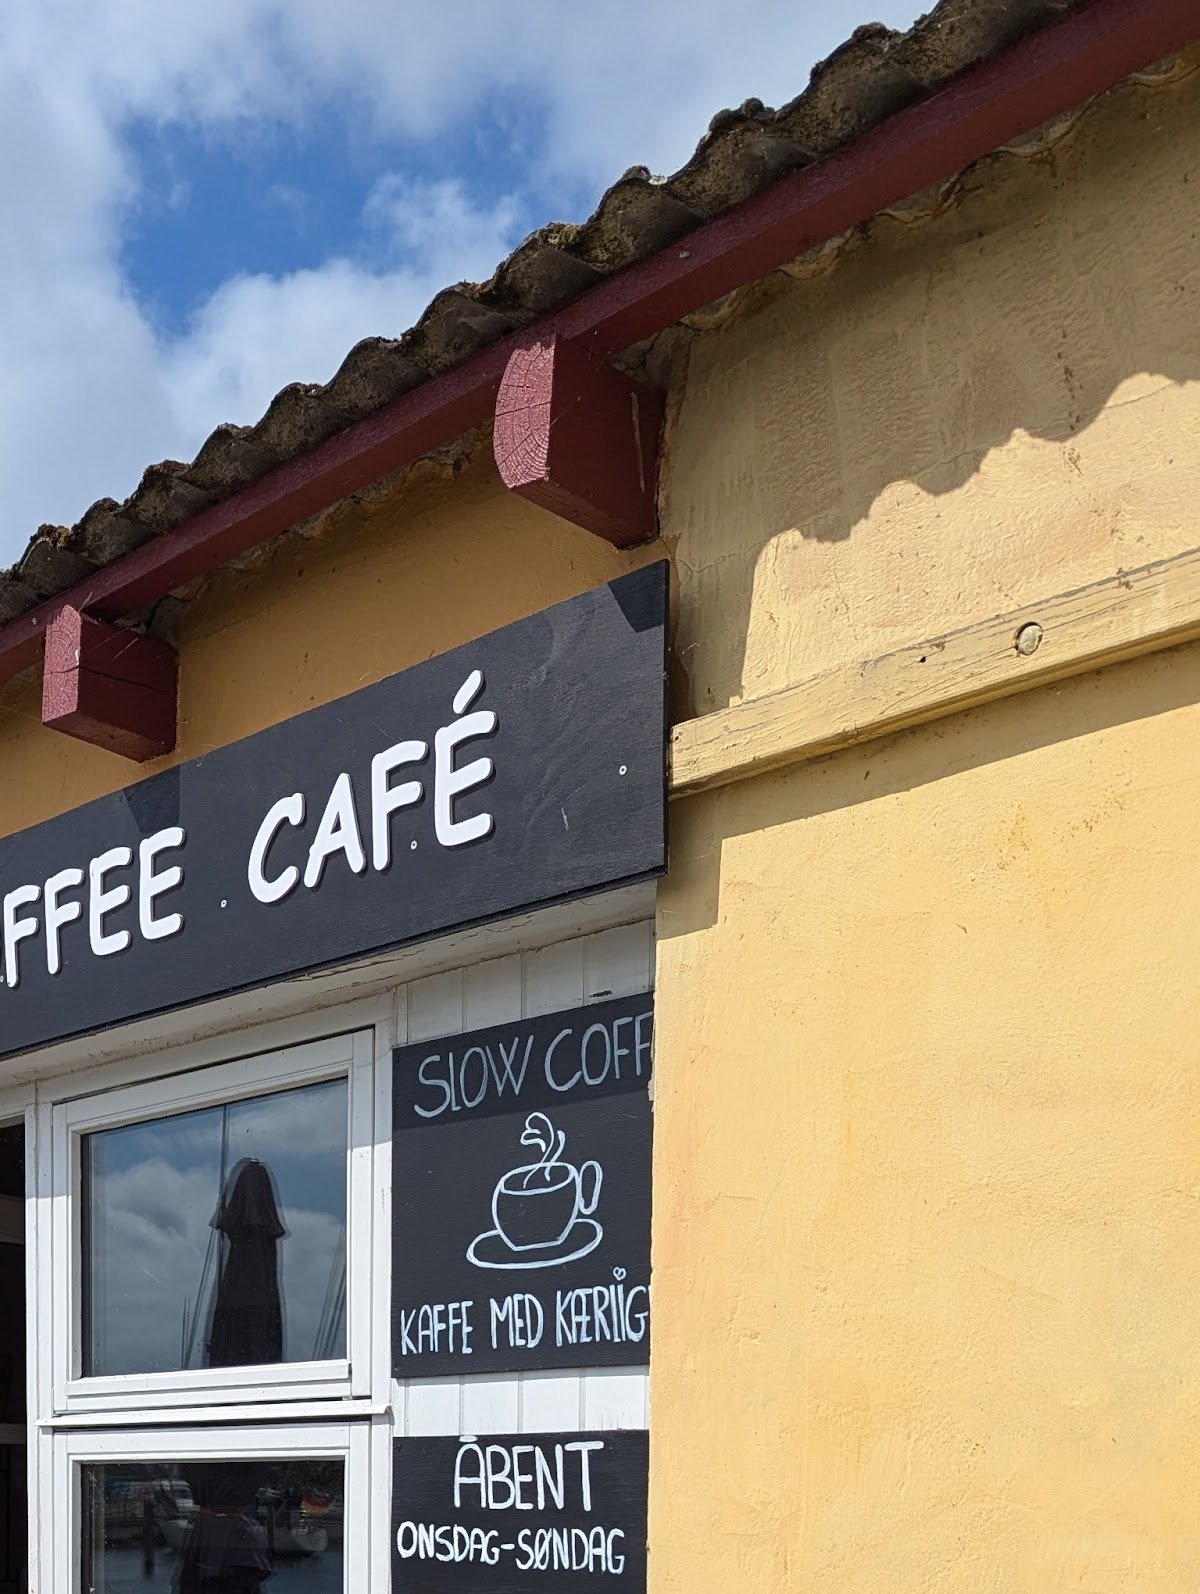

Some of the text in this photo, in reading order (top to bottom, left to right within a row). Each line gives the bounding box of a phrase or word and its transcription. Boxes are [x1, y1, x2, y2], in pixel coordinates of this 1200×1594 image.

[247, 669, 496, 903] CAFÉ
[413, 1035, 534, 1118] SLOW
[400, 1300, 474, 1356] KAFFE
[489, 1293, 544, 1349] MED
[450, 1433, 605, 1512] ÅBENT
[396, 1520, 625, 1575] ONSDAG-SØNDAG
